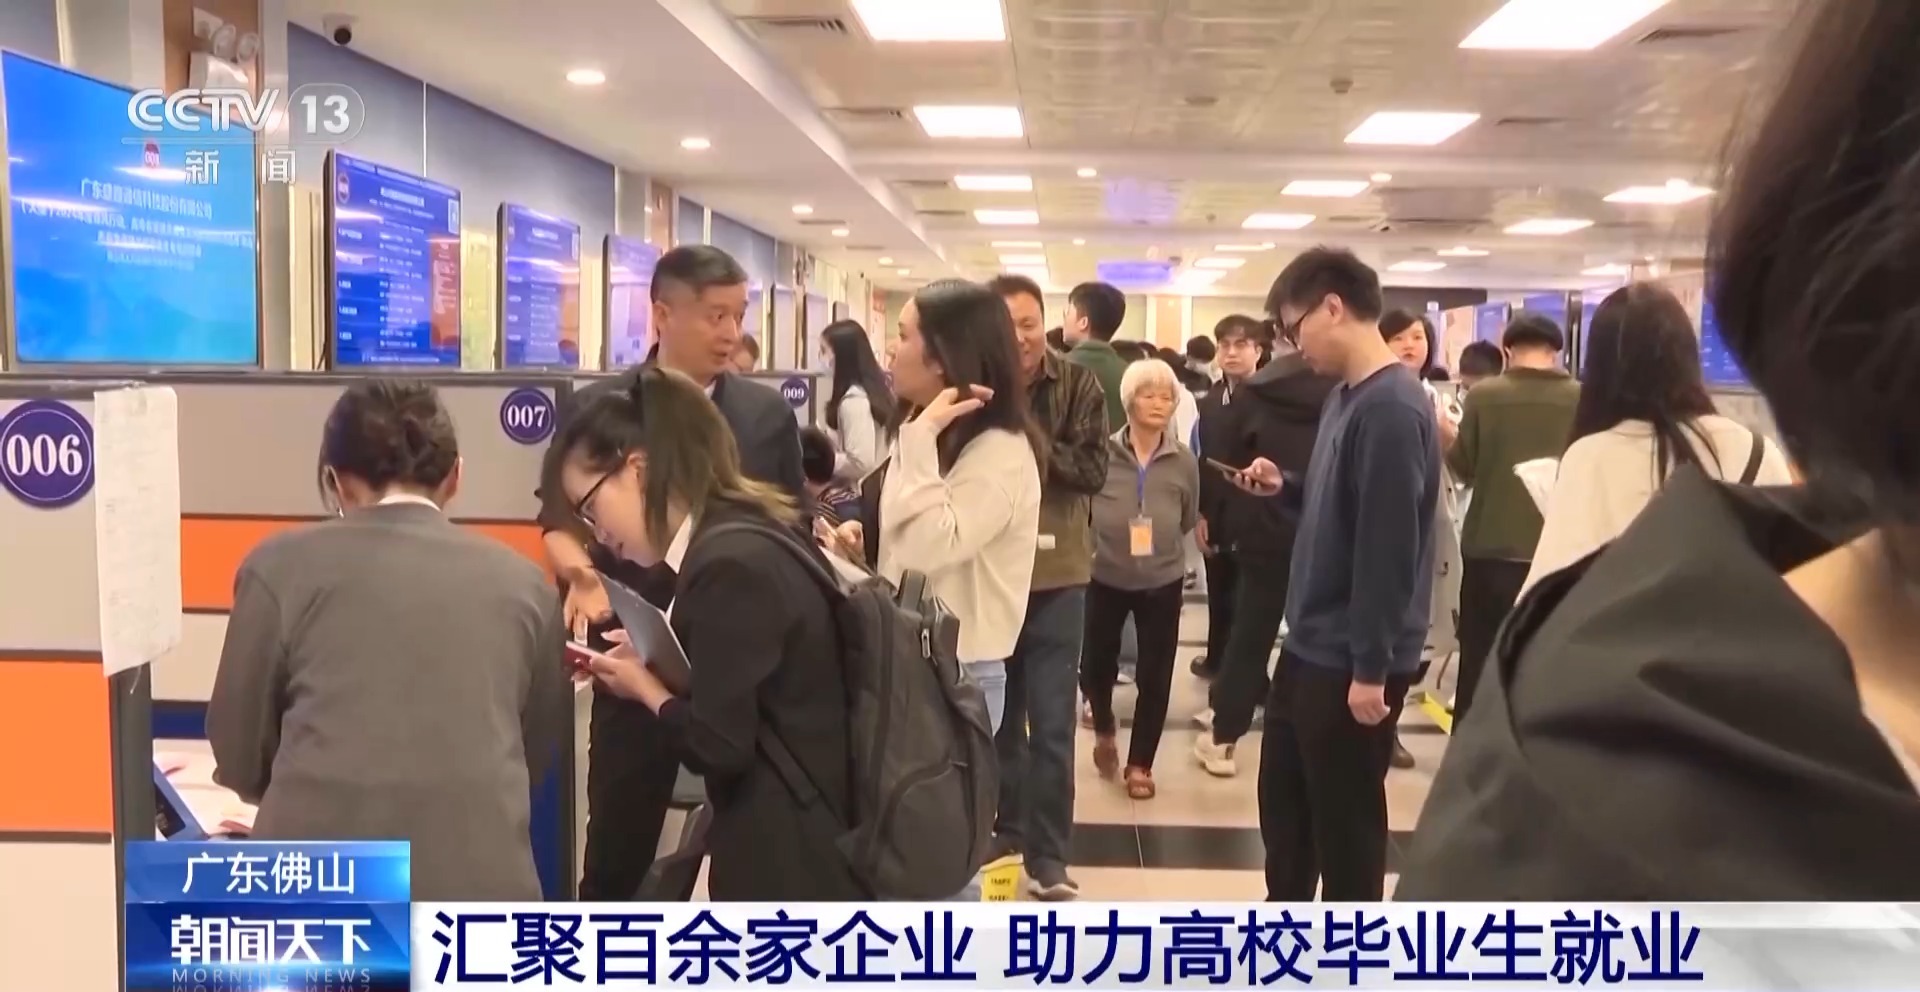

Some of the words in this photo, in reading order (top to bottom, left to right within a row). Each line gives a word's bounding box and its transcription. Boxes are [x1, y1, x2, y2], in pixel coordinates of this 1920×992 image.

[784, 387, 804, 399] 009
[507, 405, 546, 427] 007
[6, 433, 83, 476] 006
